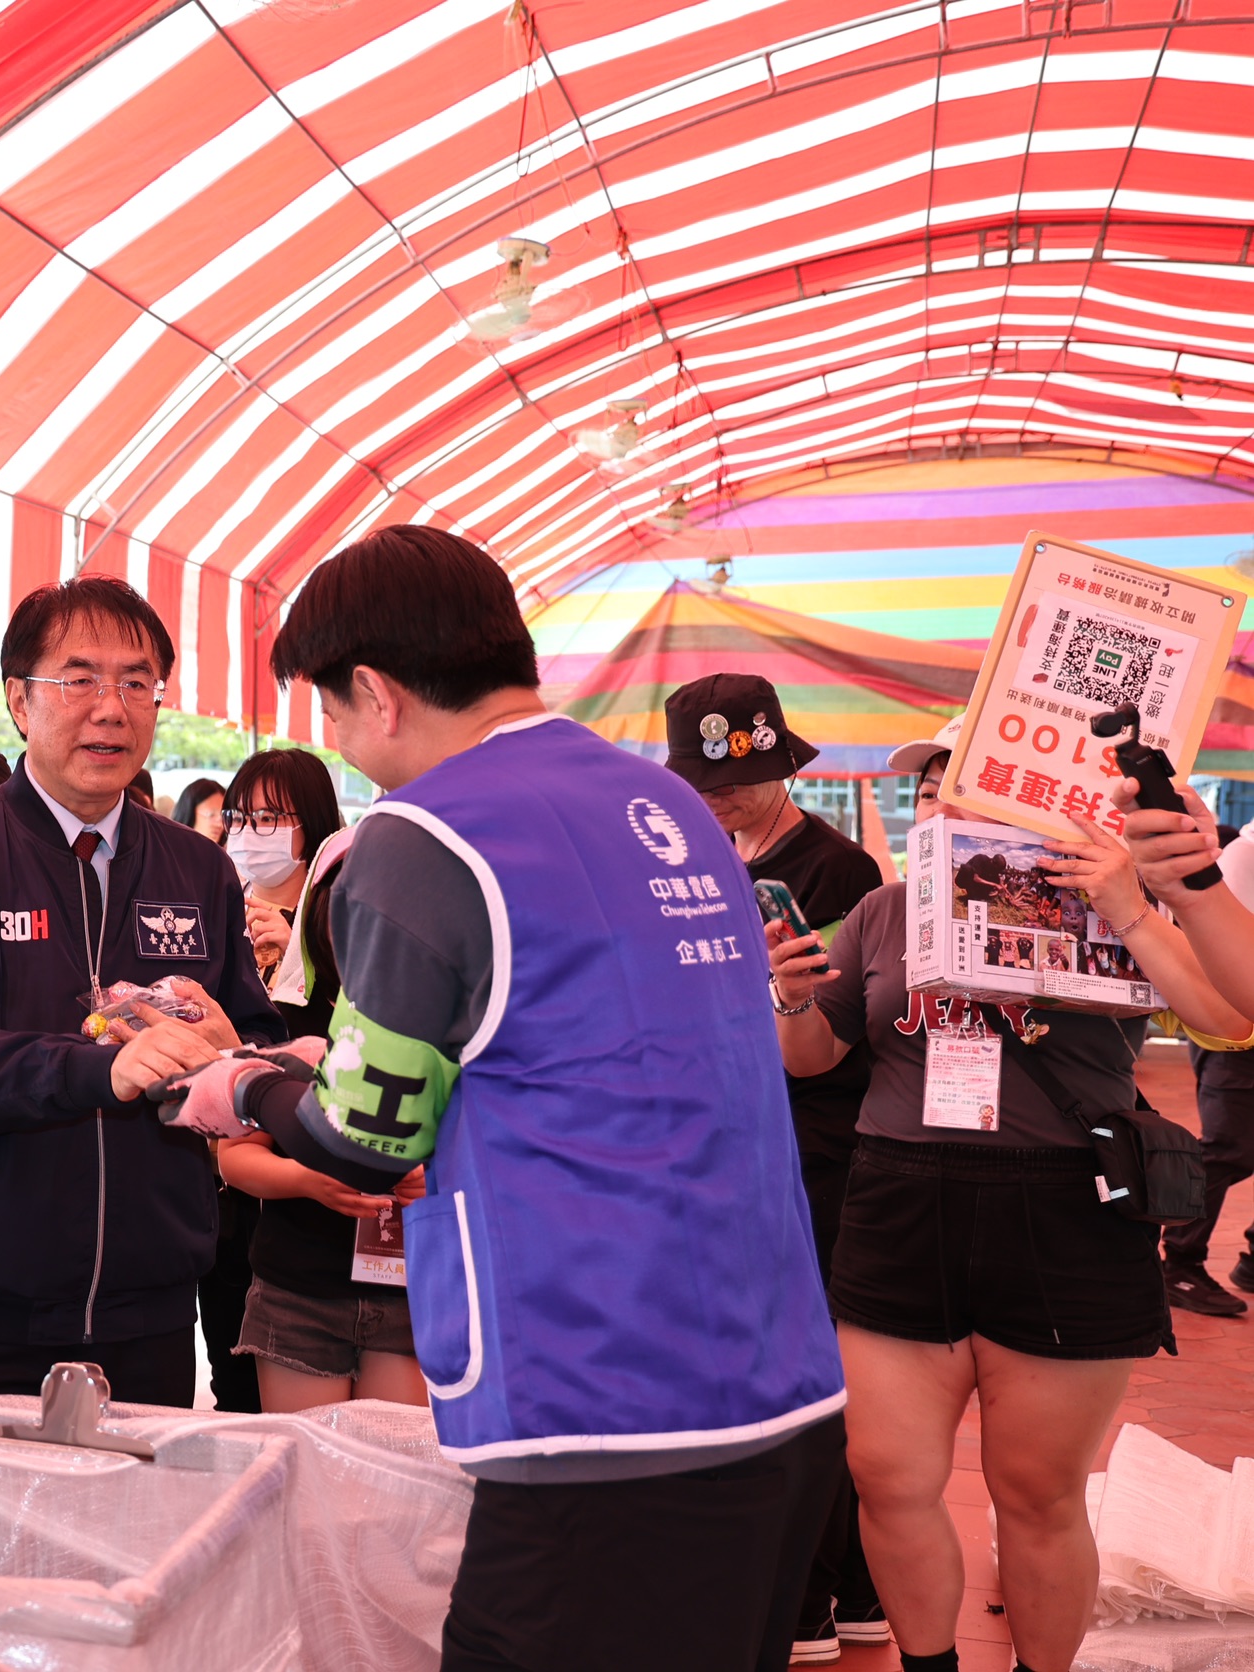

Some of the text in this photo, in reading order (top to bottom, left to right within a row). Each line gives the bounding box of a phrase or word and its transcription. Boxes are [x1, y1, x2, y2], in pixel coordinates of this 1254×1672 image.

[1038, 607, 1071, 670] 支持海運費
[1091, 664, 1116, 677] LINE
[1098, 651, 1119, 665] Pay
[1143, 662, 1175, 719] 邀您一起
[649, 874, 721, 901] 中華電信
[676, 936, 742, 965] 企業志工
[362, 1260, 404, 1274] 工作人員
